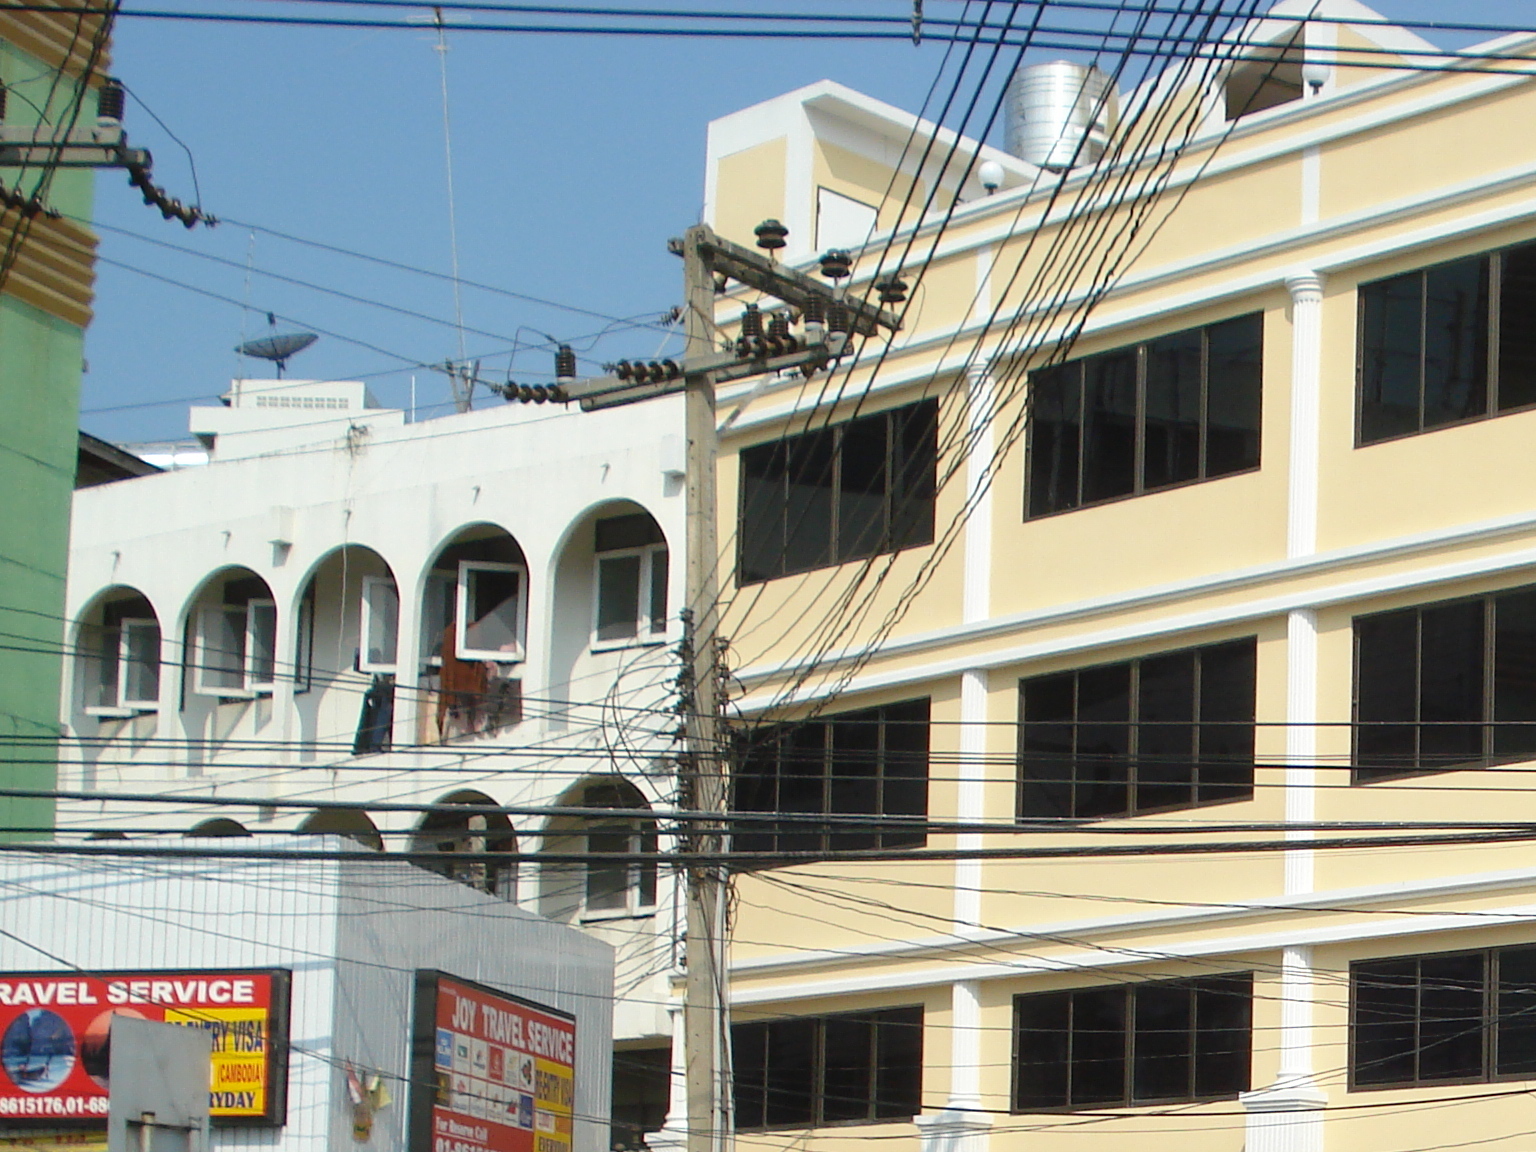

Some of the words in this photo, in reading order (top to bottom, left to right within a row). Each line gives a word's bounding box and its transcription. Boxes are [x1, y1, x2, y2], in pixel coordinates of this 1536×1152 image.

[107, 980, 254, 1004] SERVICE
[232, 1020, 263, 1052] VISA
[452, 996, 477, 1033] JOY
[482, 1005, 525, 1049] TRAVEL
[528, 1019, 573, 1065] SERVICE
[217, 1064, 264, 1087] (CAMBODIA)
[209, 1092, 255, 1108] RYDAY
[435, 1116, 447, 1131] For
